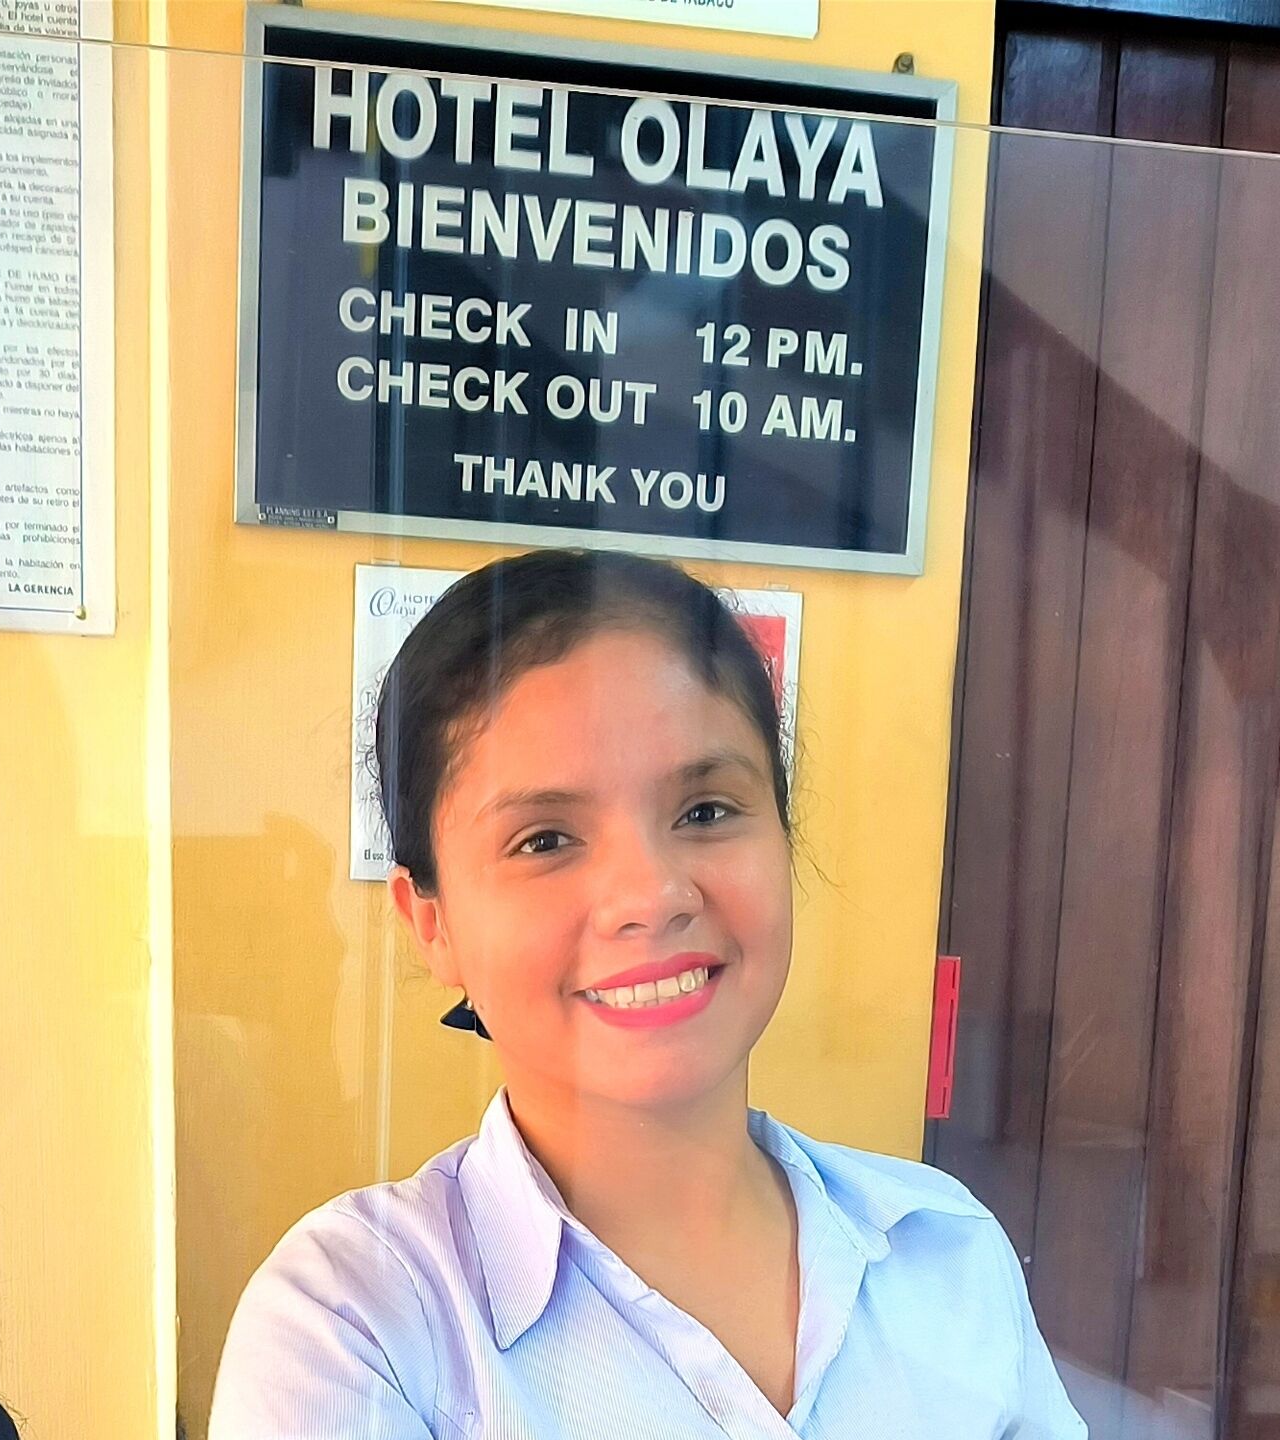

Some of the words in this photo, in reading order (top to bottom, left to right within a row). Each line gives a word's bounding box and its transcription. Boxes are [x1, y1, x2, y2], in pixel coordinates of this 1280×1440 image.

[8, 11, 17, 20] El
[21, 12, 44, 22] hotel
[47, 15, 77, 26] cuenta
[55, 3, 77, 13] otros
[313, 66, 594, 177] HOTEL
[621, 98, 882, 207] OLAYA
[341, 178, 850, 291] BIENVENIDOS
[337, 287, 532, 349] CHECK
[565, 307, 618, 355] IN
[696, 322, 751, 367] 12
[766, 328, 864, 376] PM.
[336, 357, 529, 415] CHECK
[546, 374, 657, 426] OUT
[693, 390, 748, 434] 10
[761, 396, 857, 443] AM.
[454, 453, 616, 504] THANK
[631, 469, 726, 513] YOU
[8, 583, 20, 593] LA
[24, 584, 74, 595] GERENCIA
